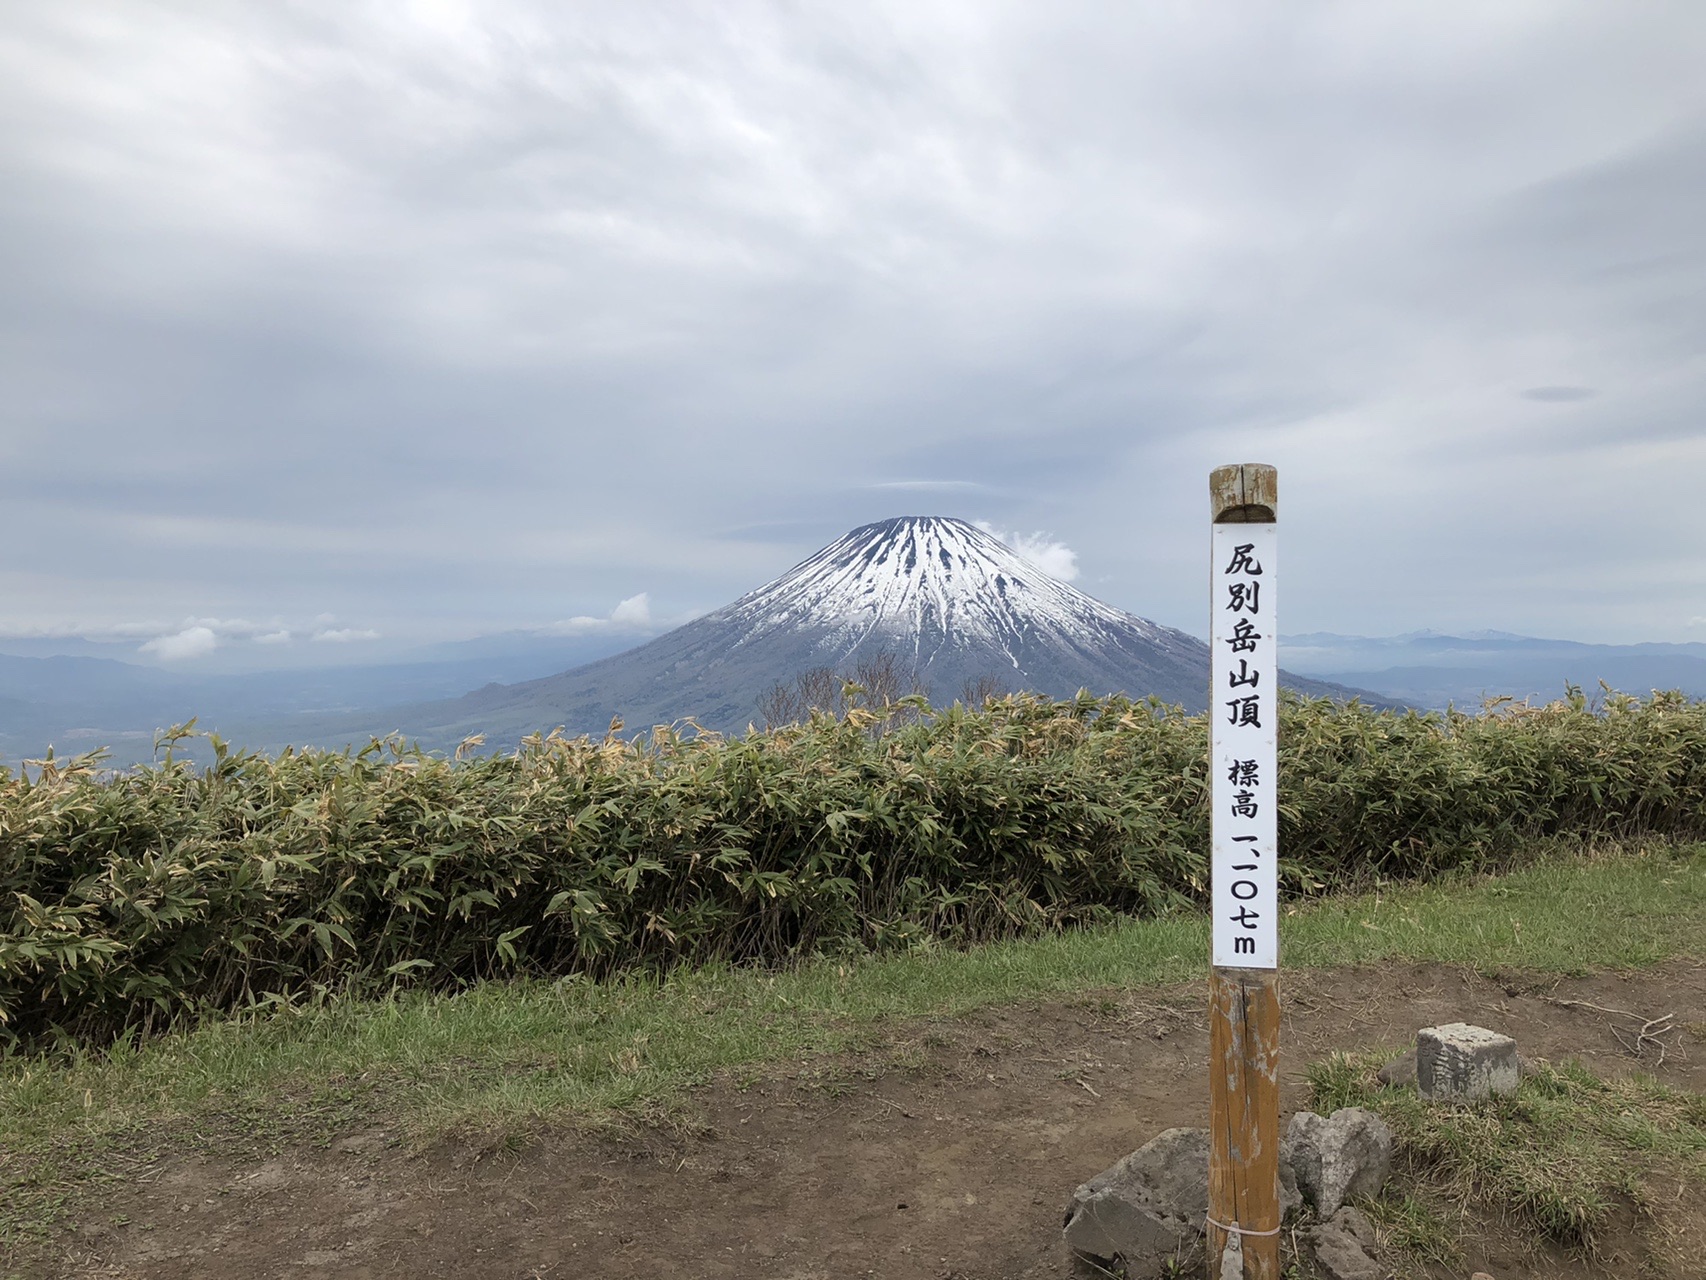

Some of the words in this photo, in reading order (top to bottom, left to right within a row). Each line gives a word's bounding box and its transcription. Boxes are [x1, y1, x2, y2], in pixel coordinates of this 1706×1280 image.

[1224, 543, 1263, 729] 尻別岳山頂
